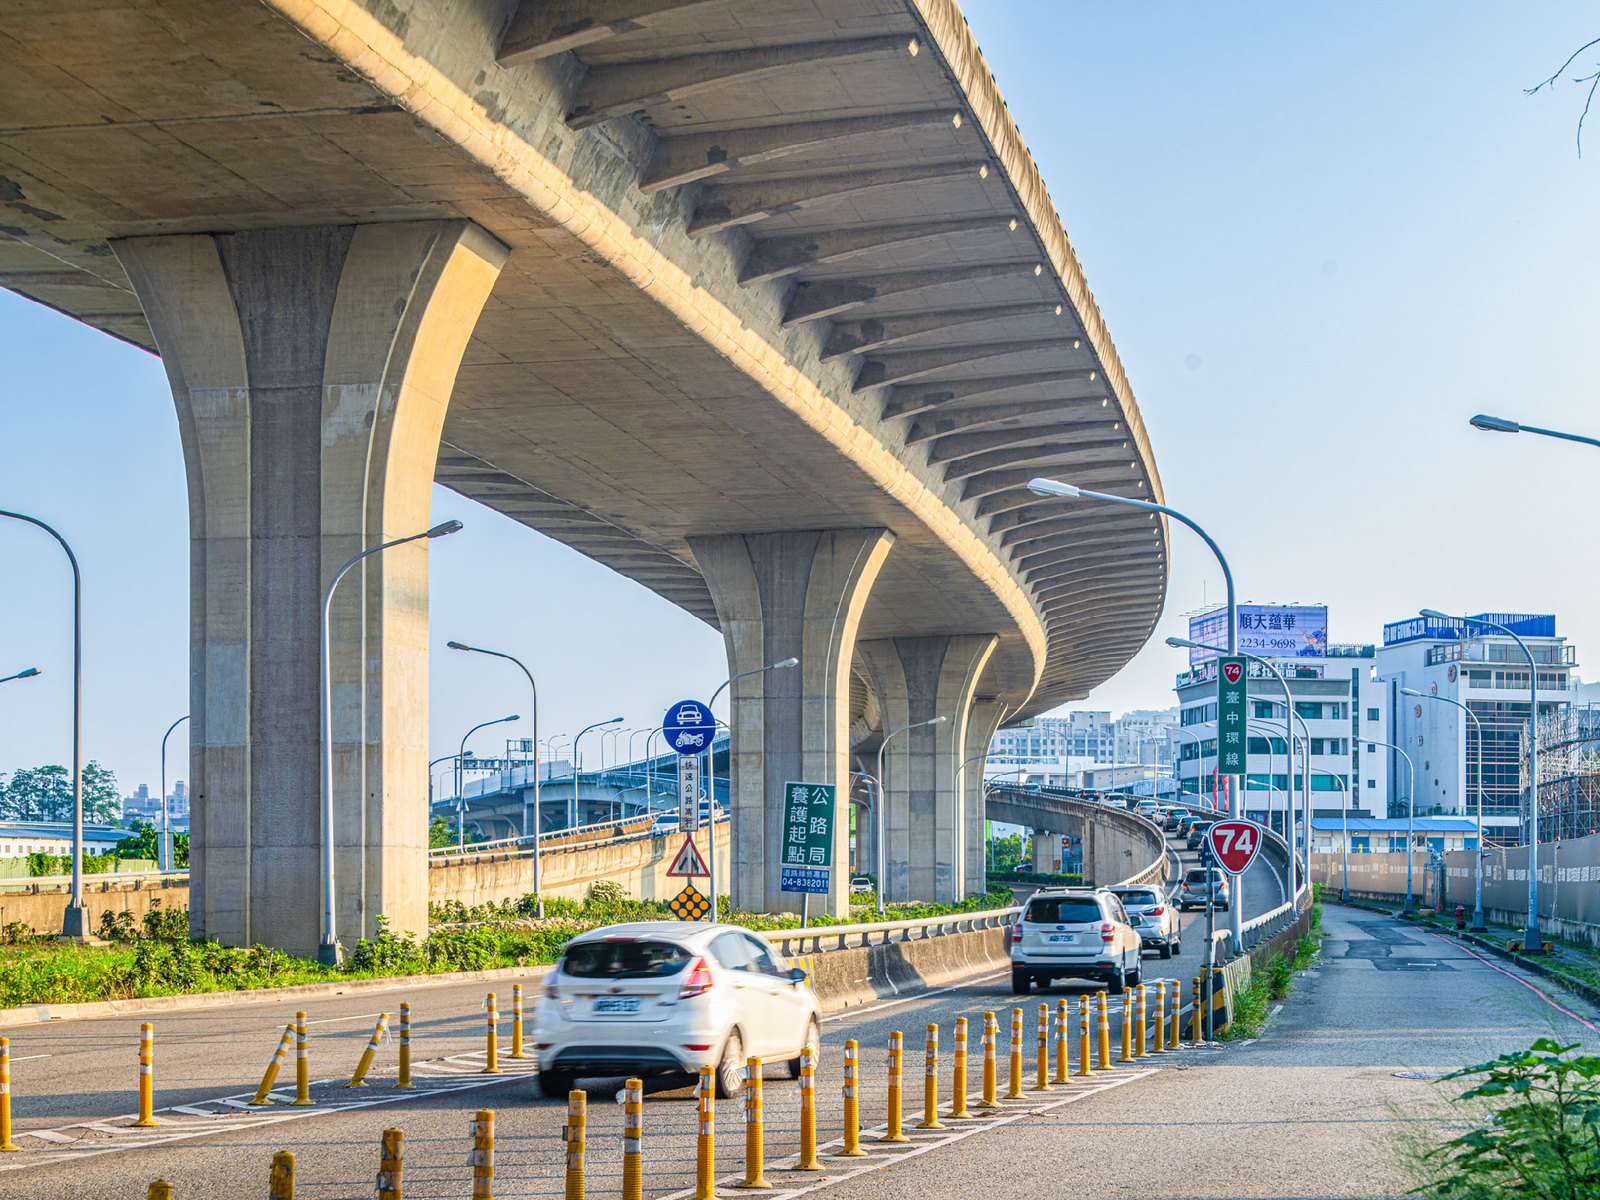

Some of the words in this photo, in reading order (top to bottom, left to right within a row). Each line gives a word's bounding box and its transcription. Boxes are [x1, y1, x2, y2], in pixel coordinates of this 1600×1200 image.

[1240, 637, 1296, 649] 2234-9698
[1225, 666, 1240, 676] 74
[1225, 690, 1240, 766] 臺中環線
[787, 785, 809, 864] 養護起點
[808, 786, 829, 864] 公路局
[1215, 829, 1253, 855] 74
